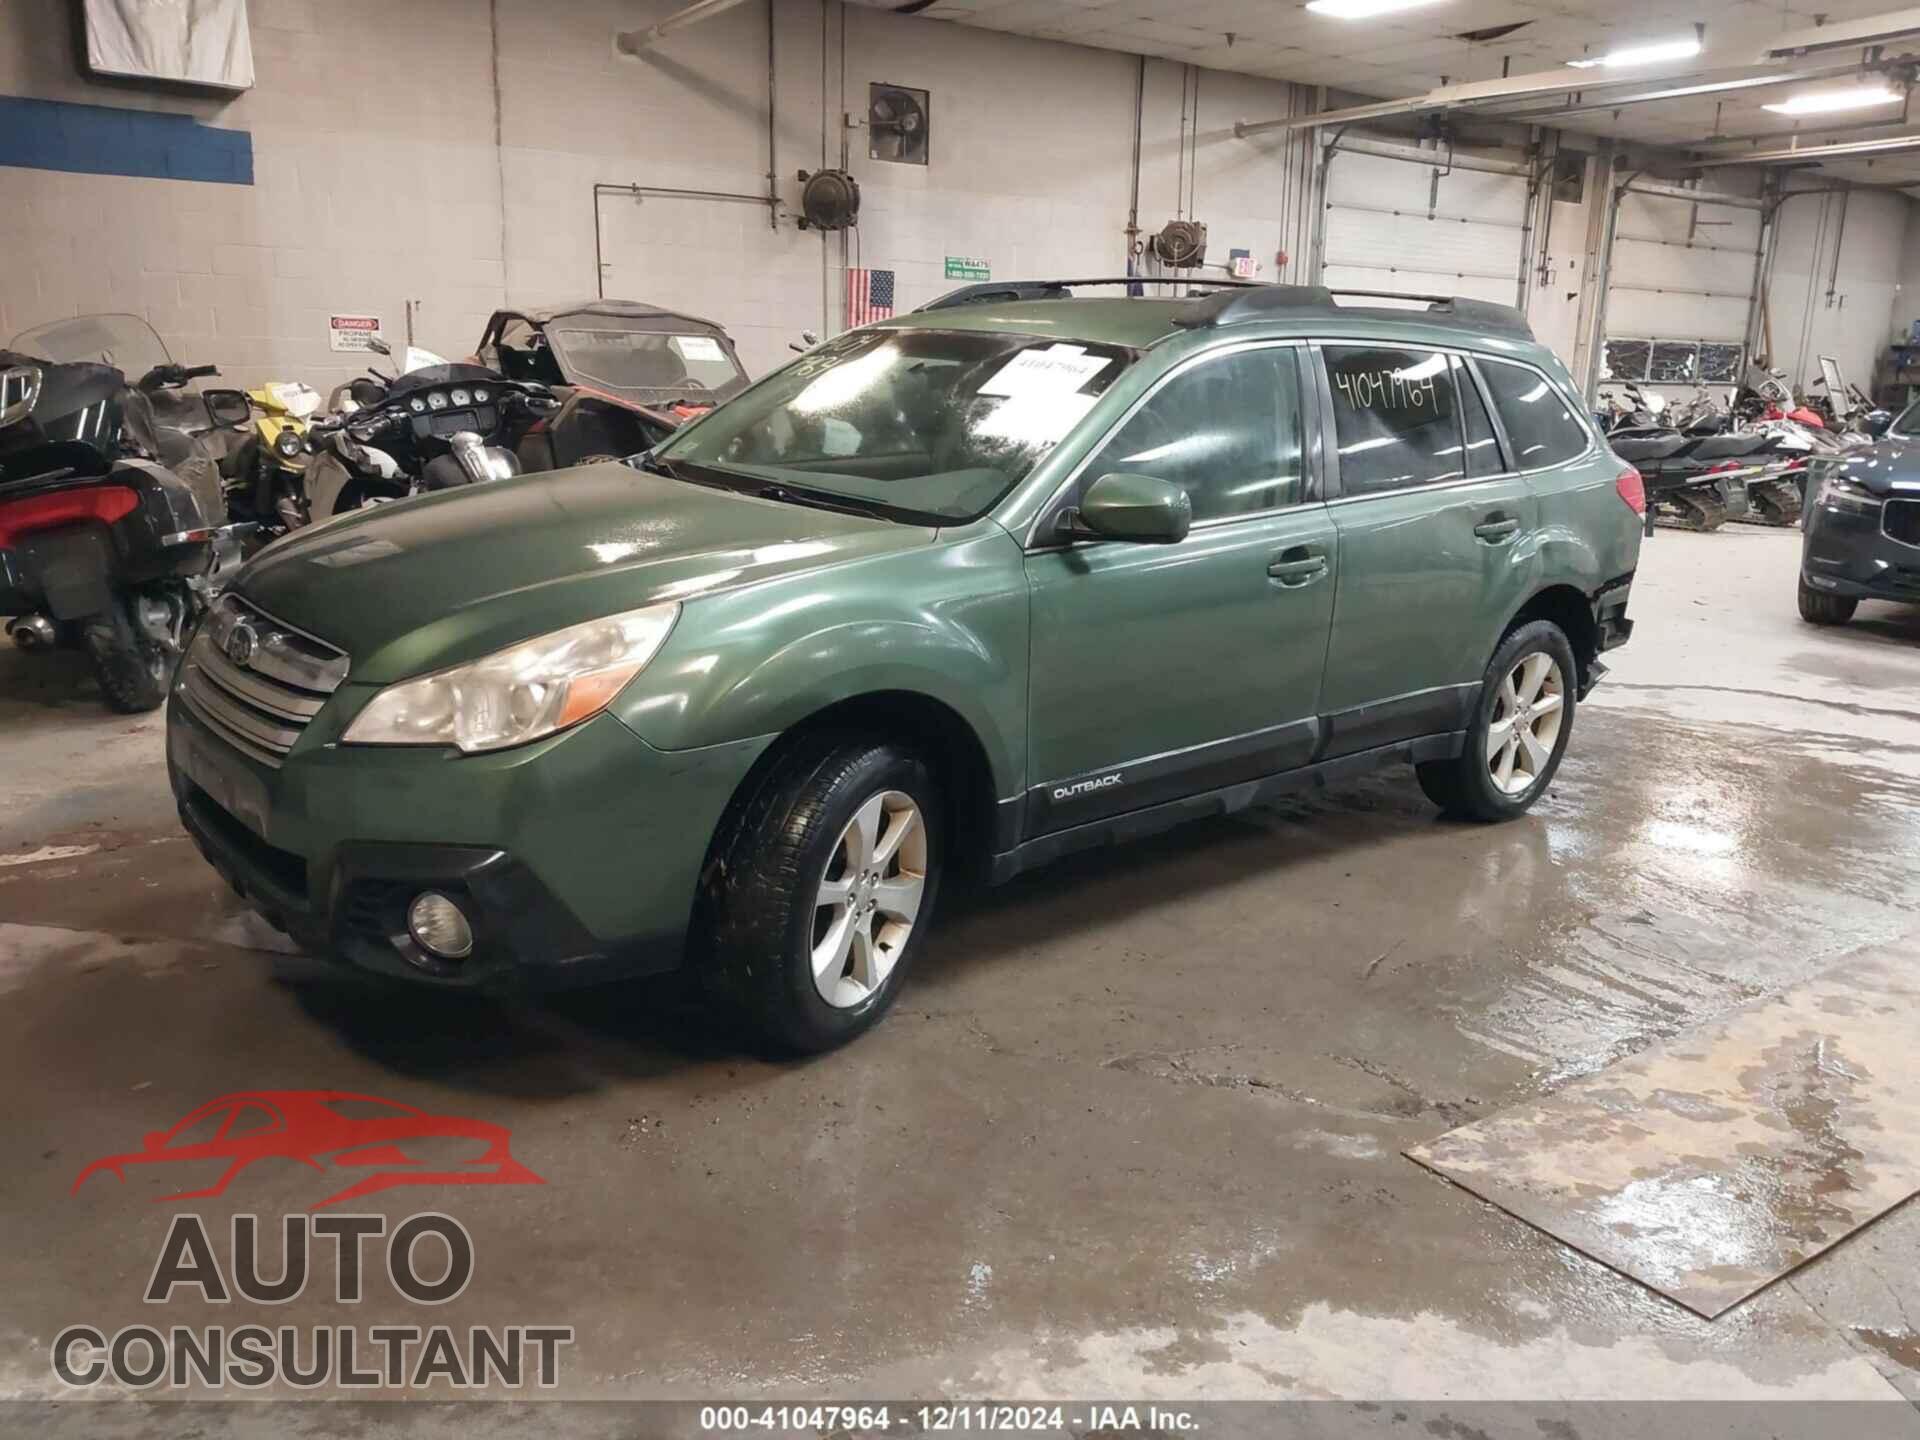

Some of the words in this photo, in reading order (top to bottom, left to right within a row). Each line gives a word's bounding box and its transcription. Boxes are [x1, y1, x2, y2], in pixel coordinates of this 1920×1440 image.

[338, 320, 372, 328] DANGER
[1335, 367, 1439, 416] 41047964
[1053, 773, 1124, 799] OUTBACK
